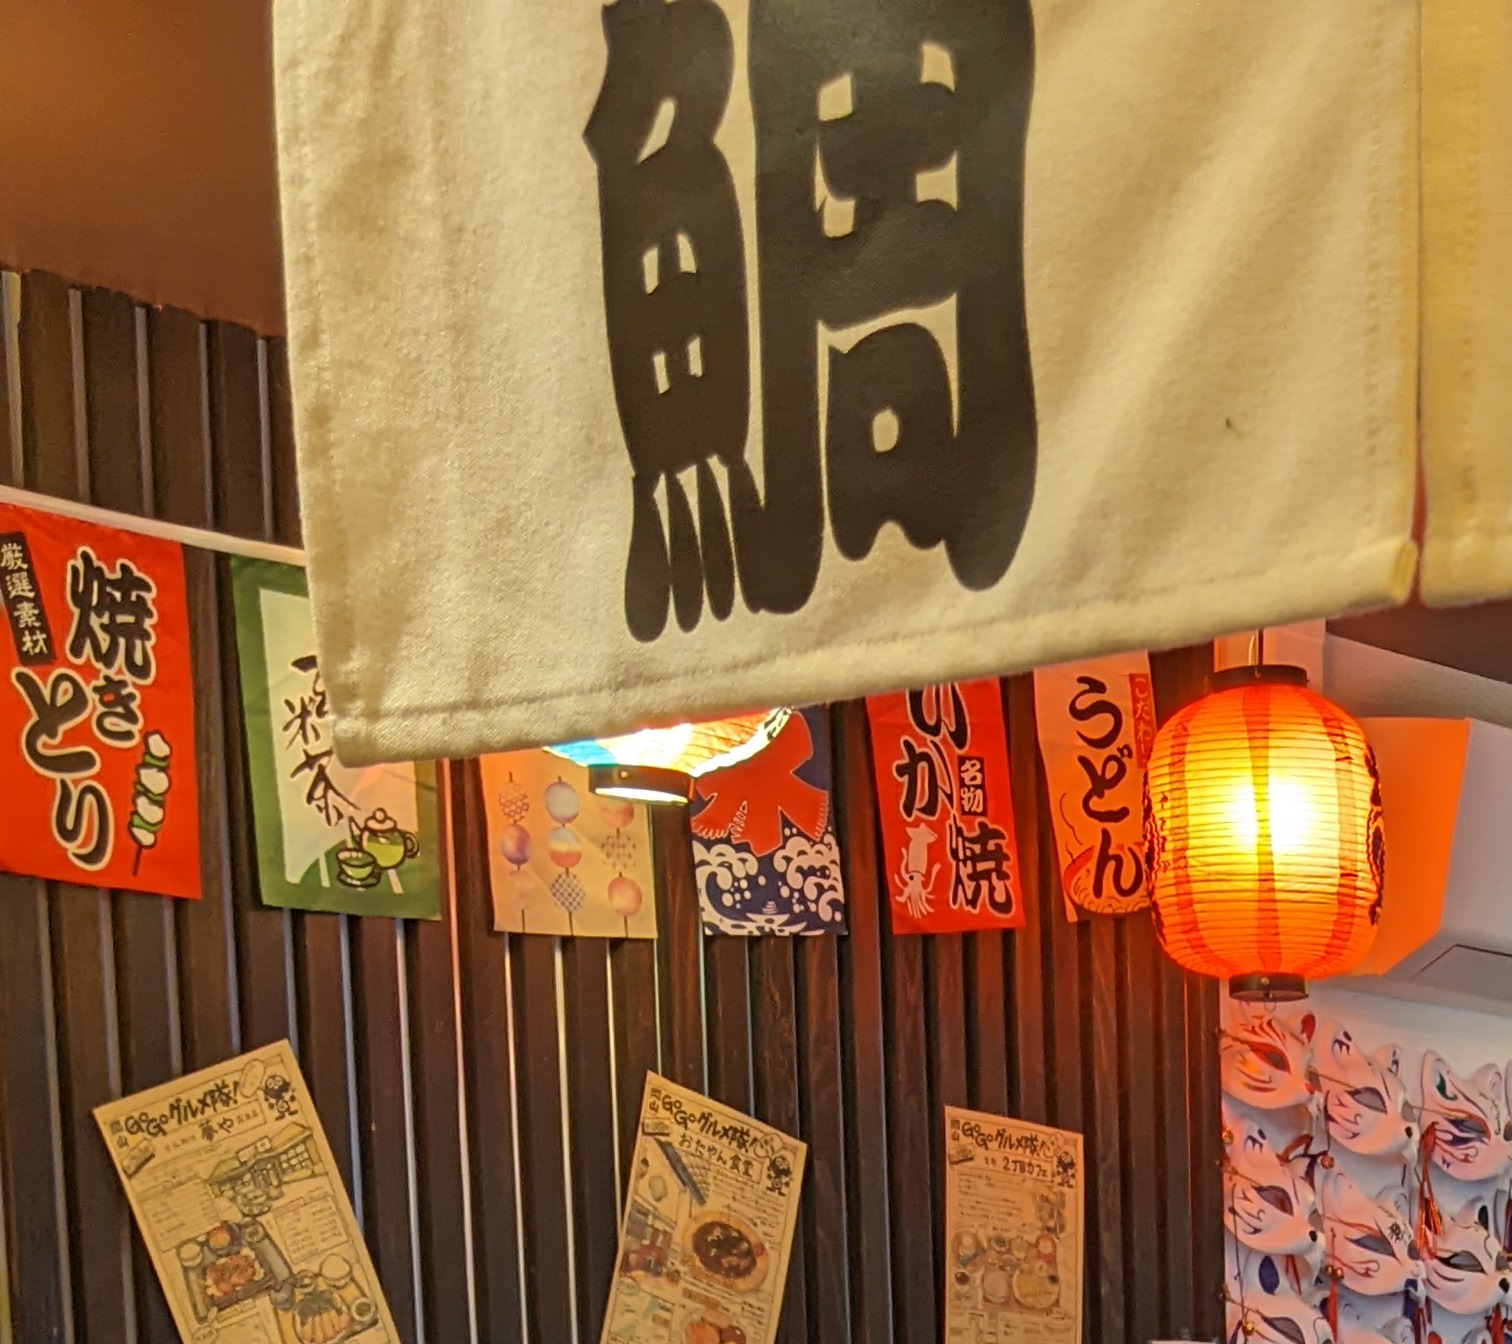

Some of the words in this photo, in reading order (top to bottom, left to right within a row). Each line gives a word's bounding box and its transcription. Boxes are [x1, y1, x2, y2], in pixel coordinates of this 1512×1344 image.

[960, 757, 985, 814] 名物
[1069, 675, 1143, 898] うどん
